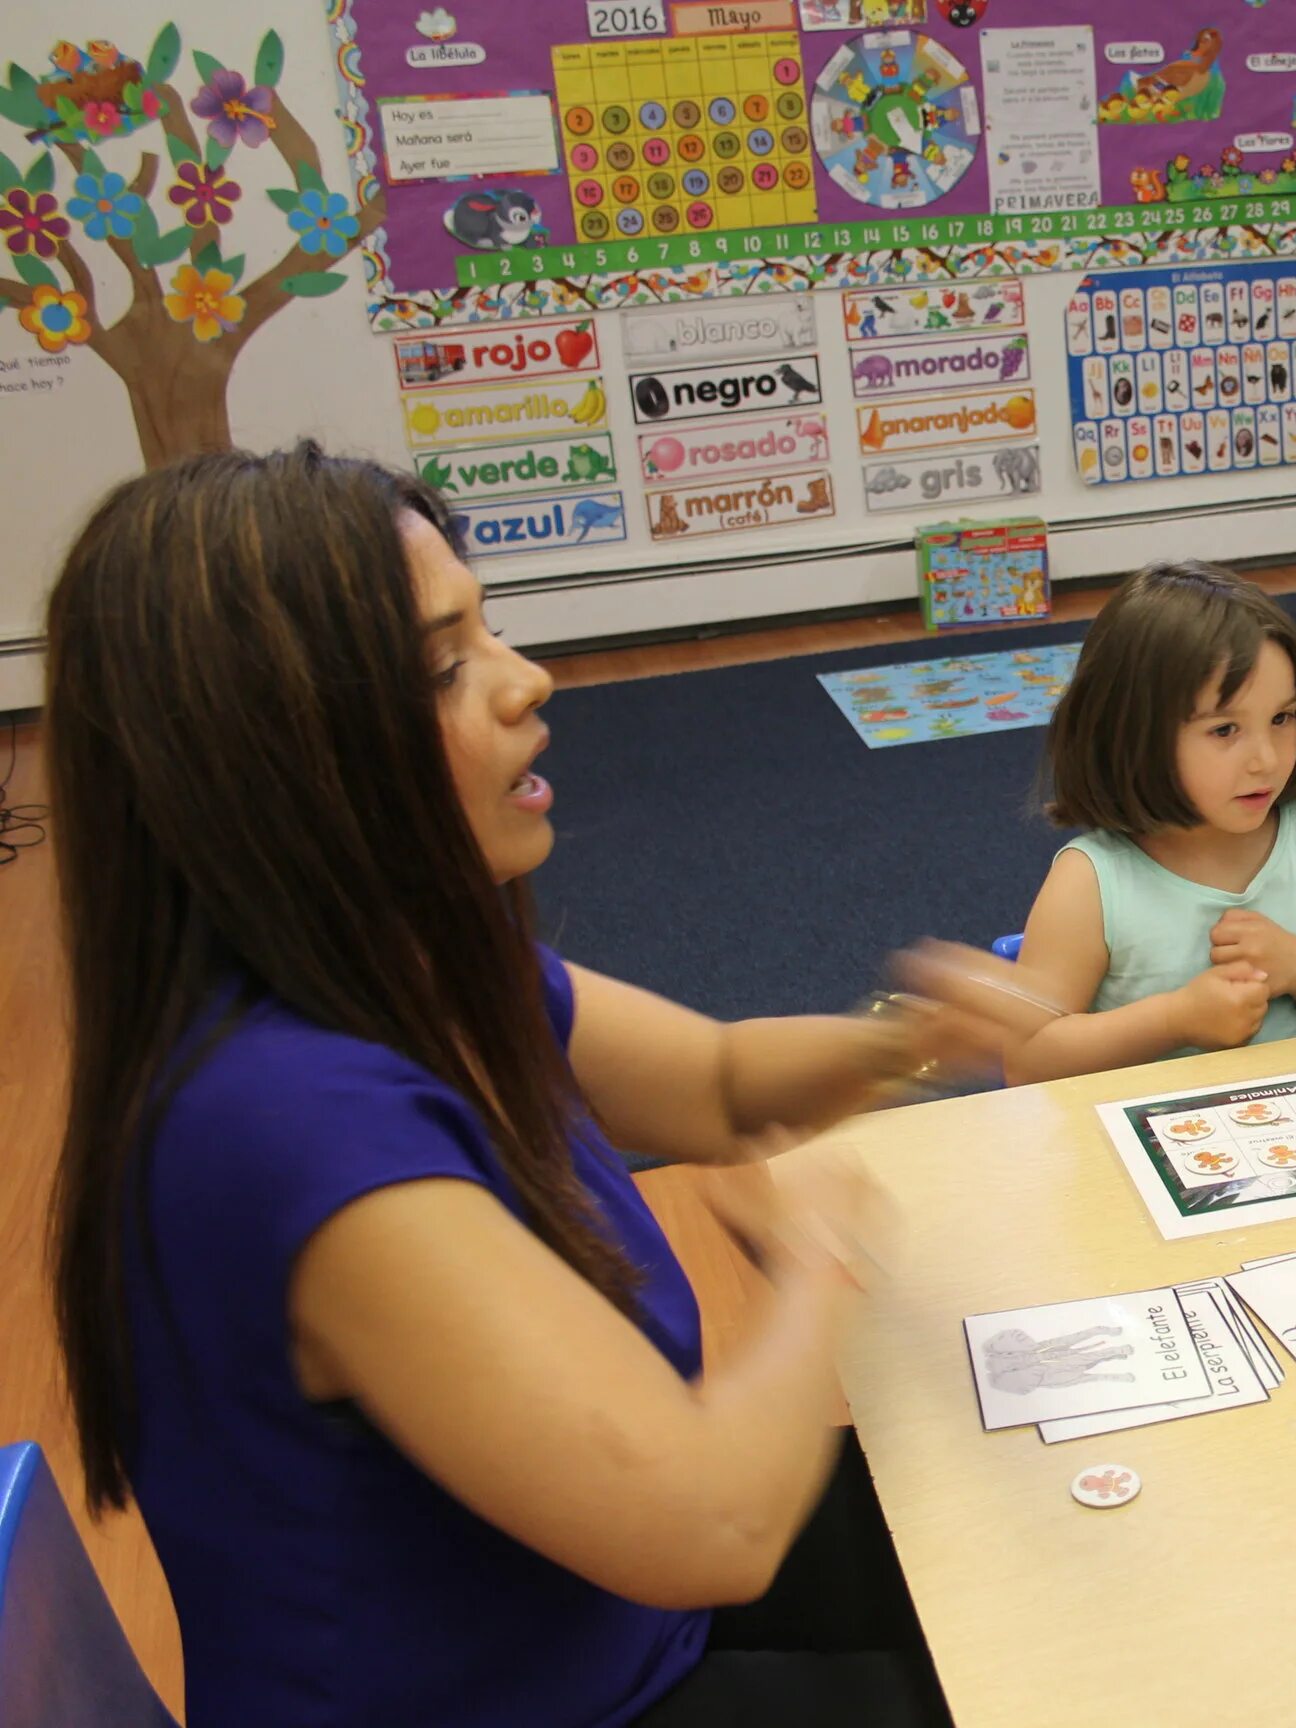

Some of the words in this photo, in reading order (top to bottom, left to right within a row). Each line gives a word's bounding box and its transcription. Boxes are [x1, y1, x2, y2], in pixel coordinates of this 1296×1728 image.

[594, 8, 657, 33] 2016
[708, 8, 762, 28] Mayo
[409, 50, 427, 62] La
[431, 47, 477, 61] libélula
[392, 110, 416, 122] Hoy
[419, 111, 434, 120] es
[396, 133, 443, 146] Mañana
[446, 131, 473, 143] será
[650, 145, 663, 158] 11
[684, 141, 699, 154] 12
[719, 139, 734, 152] 13
[753, 136, 768, 148] 14
[400, 159, 426, 174] Ayer
[431, 158, 450, 169] fue
[619, 183, 634, 195] 17
[689, 176, 704, 189] 19
[723, 173, 738, 186] 20
[758, 170, 773, 183] 21
[994, 191, 1099, 213] PRIMAVERA
[469, 262, 476, 278] 1
[500, 259, 512, 275] 2
[532, 256, 544, 272] 3
[563, 253, 575, 269] 4
[596, 249, 607, 266] 5
[627, 247, 639, 263] 6
[658, 243, 669, 260] 7
[689, 240, 700, 257] 8
[716, 238, 727, 253] 9
[743, 236, 762, 252] 10
[776, 234, 789, 250] 11
[804, 232, 821, 248] 12
[834, 230, 851, 246] 13
[864, 228, 880, 244] 14
[893, 226, 910, 242] 15
[922, 224, 939, 240] 16
[949, 222, 965, 237] 17
[977, 220, 993, 236] 18
[1005, 218, 1022, 234] 19
[1031, 217, 1052, 233] 20
[1061, 215, 1077, 231] 21
[1087, 213, 1107, 230] 22
[1114, 212, 1134, 228] 23
[1142, 210, 1161, 226] 24
[1166, 208, 1184, 224] 25
[1193, 207, 1213, 222] 26
[1220, 204, 1238, 220] 27
[1246, 203, 1264, 218] 28
[1271, 200, 1290, 217] 29
[1069, 300, 1089, 312] Aa
[1095, 297, 1113, 311] Bb
[1123, 294, 1140, 308] Cc
[1175, 291, 1195, 304] Dd
[1204, 289, 1219, 302] Ee
[1230, 288, 1243, 301] Ff
[1253, 285, 1272, 302] Gg
[676, 317, 777, 346] blanco
[472, 334, 551, 371] rojo
[895, 347, 999, 378] morado
[1112, 360, 1129, 373] Kk
[674, 374, 777, 408] negro
[445, 394, 569, 428] amarillo
[1076, 427, 1096, 442] Qq
[1105, 424, 1119, 438] Rr
[1131, 421, 1147, 435] Ss
[1157, 420, 1173, 432] Tt
[1182, 417, 1202, 431] Uu
[1209, 415, 1227, 428] Vv
[1260, 410, 1276, 423] Xx
[689, 430, 796, 466] rosado
[457, 450, 559, 487] verde
[920, 459, 982, 500] gris
[685, 479, 794, 517] marrón
[474, 504, 565, 544] azul
[720, 509, 769, 529] (café)
[1146, 1305, 1180, 1362] elefante
[1160, 1365, 1187, 1381] El
[1217, 1377, 1240, 1396] La
